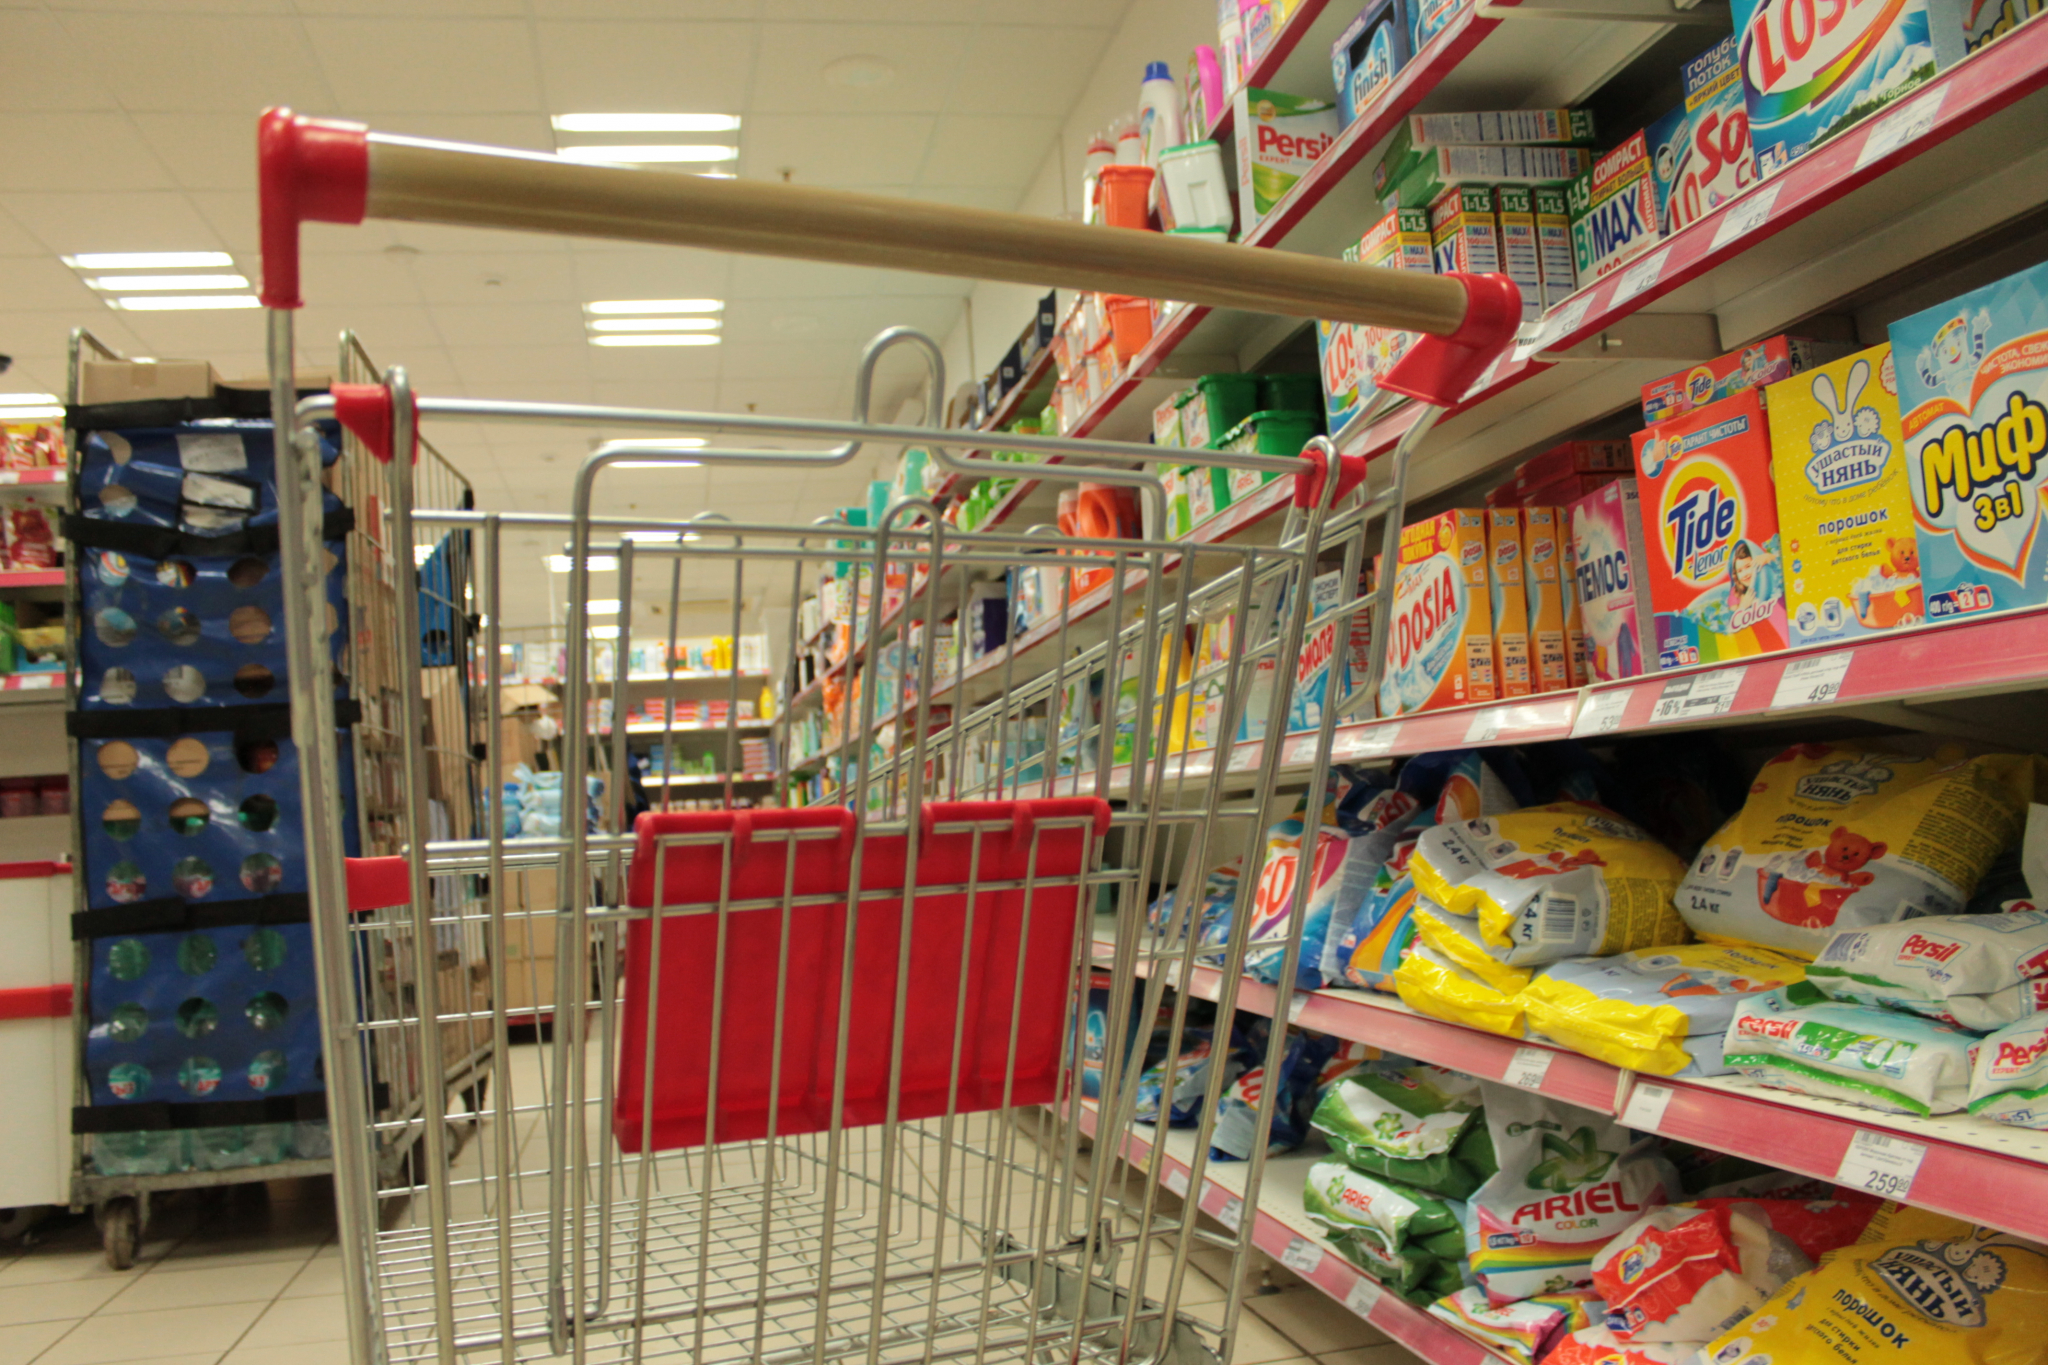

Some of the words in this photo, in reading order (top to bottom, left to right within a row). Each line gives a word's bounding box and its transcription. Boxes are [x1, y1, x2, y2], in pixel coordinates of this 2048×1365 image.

[1353, 50, 1389, 106] finish
[1594, 136, 1643, 185] COMPACT
[1462, 196, 1491, 211] 1=1,5
[1501, 196, 1529, 212] 1=1,5
[1537, 198, 1565, 213] 1=1,5
[1642, 177, 1655, 231] AUTOMAT
[1400, 216, 1427, 231] 1=1,5
[2021, 342, 2048, 356] СВЕЖ
[1751, 363, 1777, 382] Color
[1999, 354, 2048, 374] ЭКОНОМИ
[1689, 375, 1712, 401] Tide
[1709, 417, 1747, 440] ЧИСТОТЫ
[1908, 402, 1945, 432] АВТОМАТ
[1921, 391, 2048, 518] Миф
[1401, 520, 1435, 547] ЫГОДНАЯ
[1666, 484, 1736, 578] Tide
[1818, 508, 1889, 535] порошок
[1850, 541, 1873, 551] стирки
[1398, 566, 1457, 670] DOSIA
[1730, 599, 1776, 630] Color
[1808, 684, 1828, 702] 49
[1900, 934, 1962, 963] Persil
[1737, 1015, 1799, 1039] Persil
[1864, 1170, 1898, 1194] 259
[1342, 1188, 1373, 1214] ARIEL
[1512, 1181, 1639, 1225] ARIEL
[1555, 1218, 1599, 1231] COLOR
[1832, 1288, 1909, 1349] порошок
[1819, 1318, 1833, 1330] для
[1831, 1325, 1861, 1352] стирки
